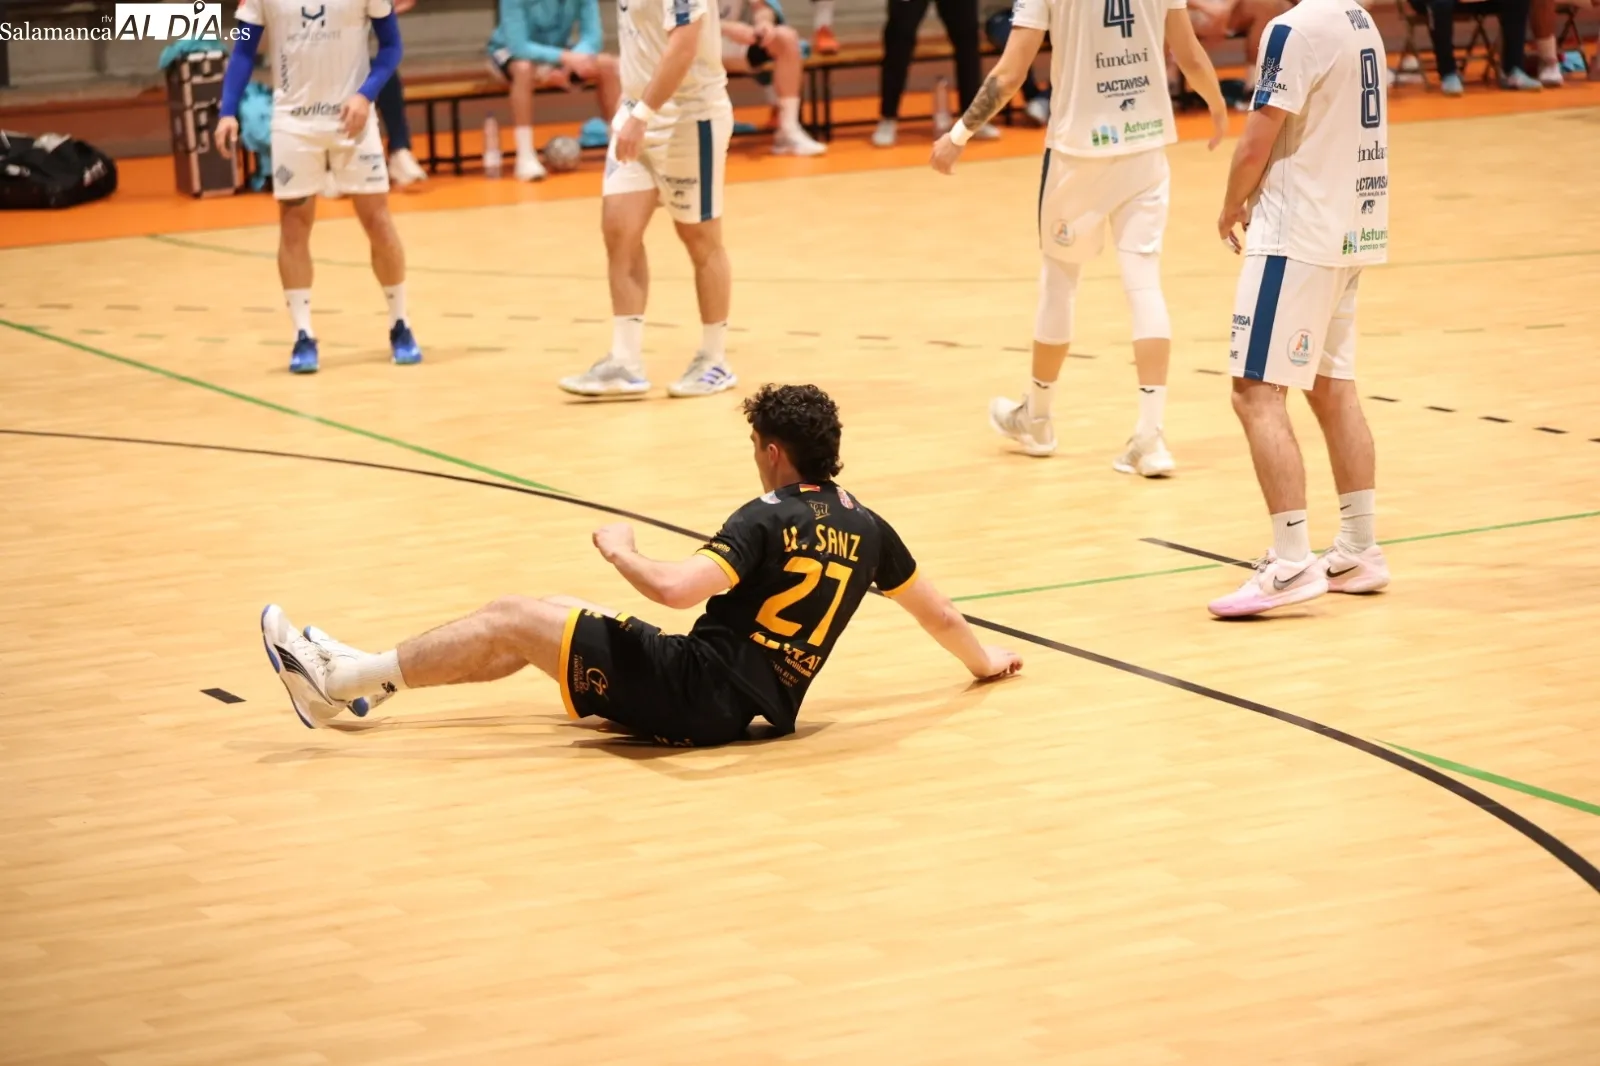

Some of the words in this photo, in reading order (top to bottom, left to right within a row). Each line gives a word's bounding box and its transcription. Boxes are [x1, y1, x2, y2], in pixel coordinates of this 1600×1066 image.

[1103, 0, 1135, 38] 4
[1095, 47, 1149, 69] fundavi
[1359, 47, 1381, 129] 8
[815, 523, 861, 562] SANZ
[755, 556, 853, 647] 27
